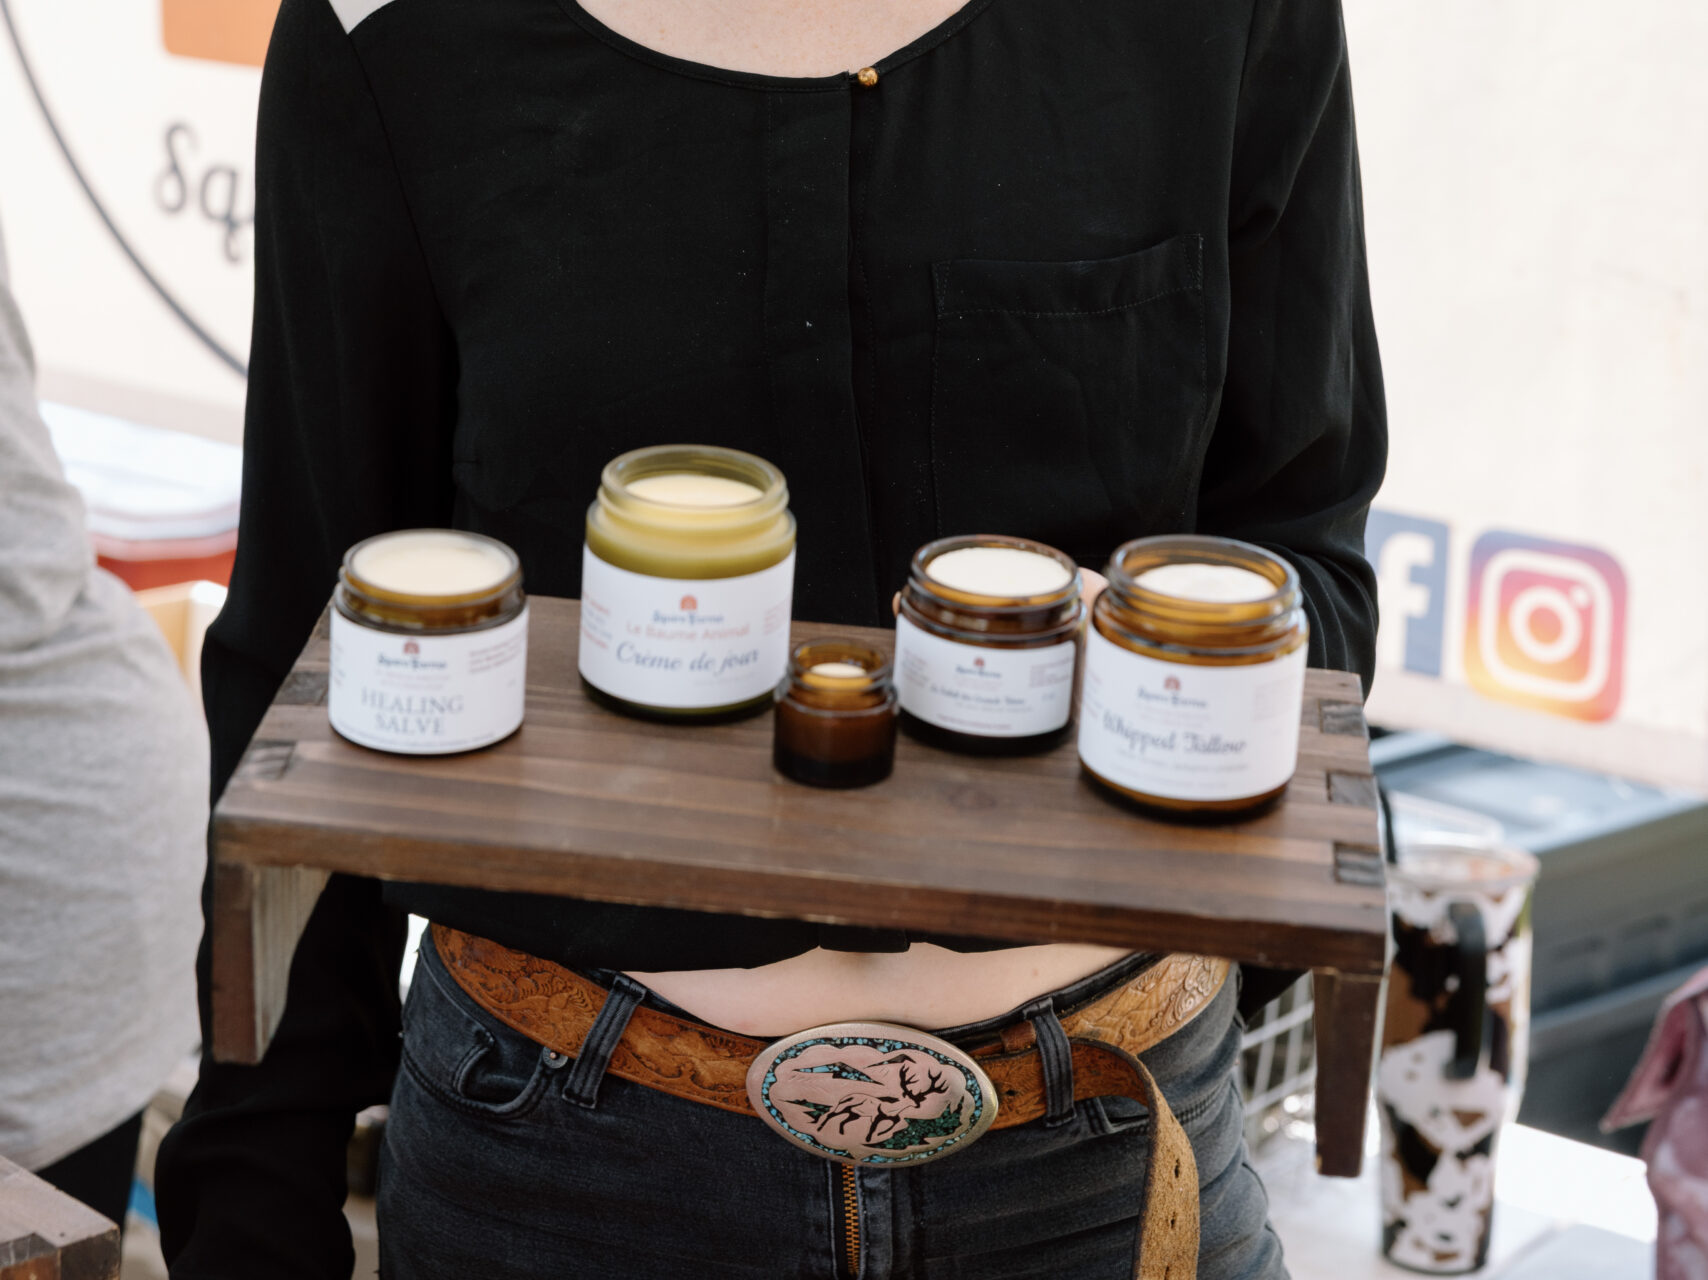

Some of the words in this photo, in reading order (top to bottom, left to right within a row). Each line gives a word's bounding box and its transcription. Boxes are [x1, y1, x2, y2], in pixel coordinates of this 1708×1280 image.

[153, 120, 254, 265] Sq
[688, 650, 714, 672] de
[716, 648, 760, 676] jour
[361, 686, 465, 716] HEALING
[375, 713, 446, 736] SALVE
[1102, 709, 1177, 754] Whipped
